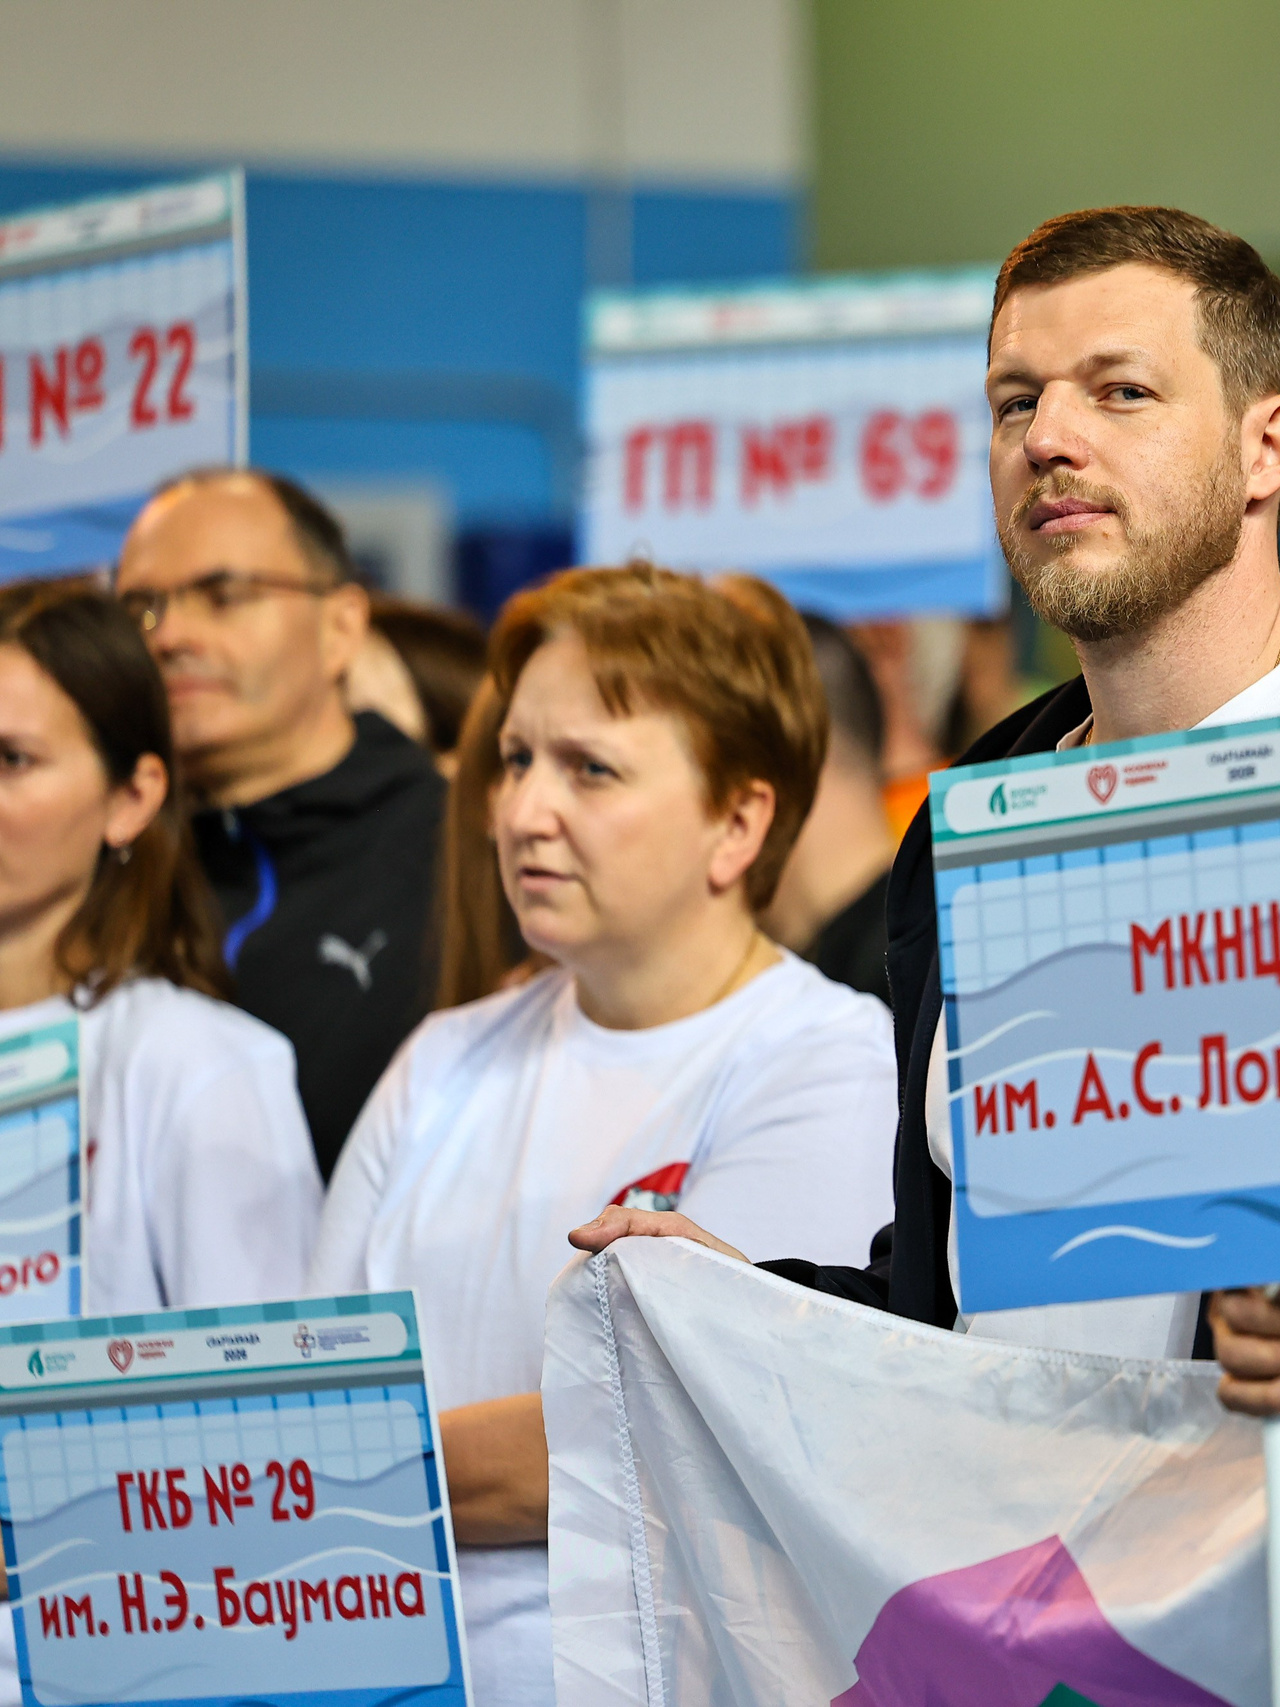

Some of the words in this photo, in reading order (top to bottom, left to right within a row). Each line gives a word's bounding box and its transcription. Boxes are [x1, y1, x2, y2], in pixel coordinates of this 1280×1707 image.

[29, 338, 105, 448] №
[129, 321, 197, 429] 22
[622, 418, 717, 512] ГП
[739, 412, 834, 502] №
[859, 407, 961, 501] 69
[973, 1079, 1057, 1137] им.
[1072, 1040, 1182, 1126] А.С.
[116, 1467, 195, 1533] ГКБ
[203, 1463, 255, 1527] №
[265, 1458, 317, 1523] 29
[39, 1595, 110, 1640] им.
[118, 1568, 205, 1634] Н.Э.
[213, 1566, 427, 1641] Баумана
